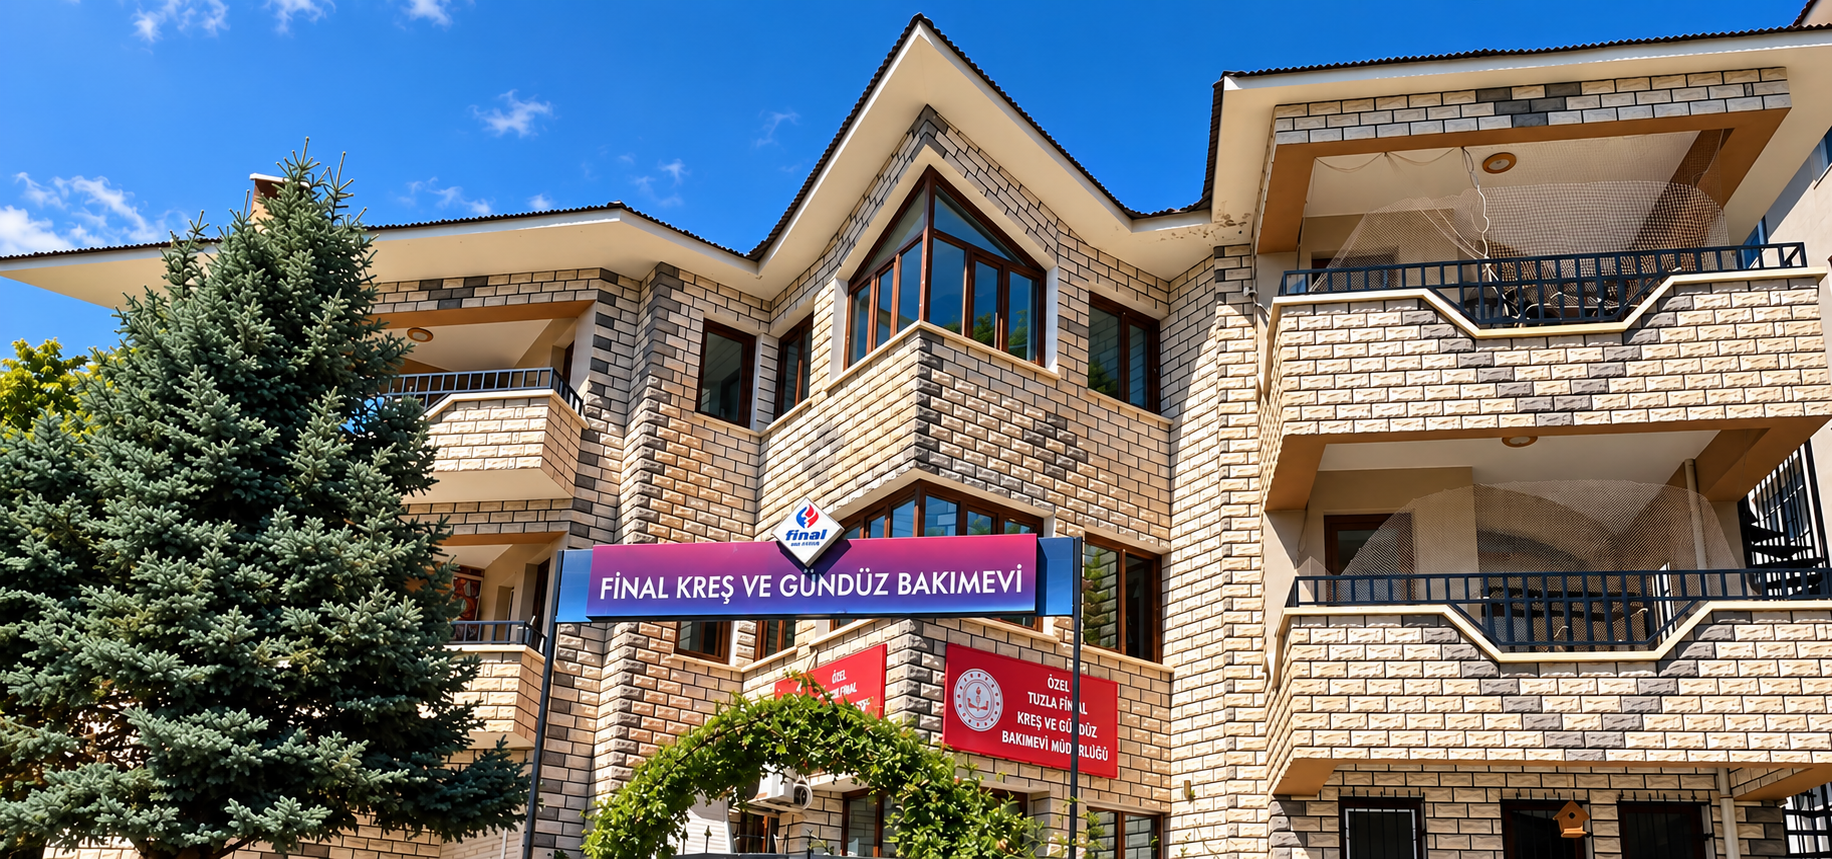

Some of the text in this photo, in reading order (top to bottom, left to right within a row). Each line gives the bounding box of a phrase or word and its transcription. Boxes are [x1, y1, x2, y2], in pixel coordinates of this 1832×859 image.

[785, 529, 828, 541] final
[600, 563, 1022, 604] FİNAL KREŞ VE GÜNDÜZ BAKIMEVİ
[1047, 673, 1070, 693] ÖZEL
[1027, 691, 1058, 710] TUZLA
[1017, 710, 1098, 739] KREŞ VE GÜDÜZ
[1002, 730, 1109, 762] BAKIMEVİ MÜDRLÜĞÜ
